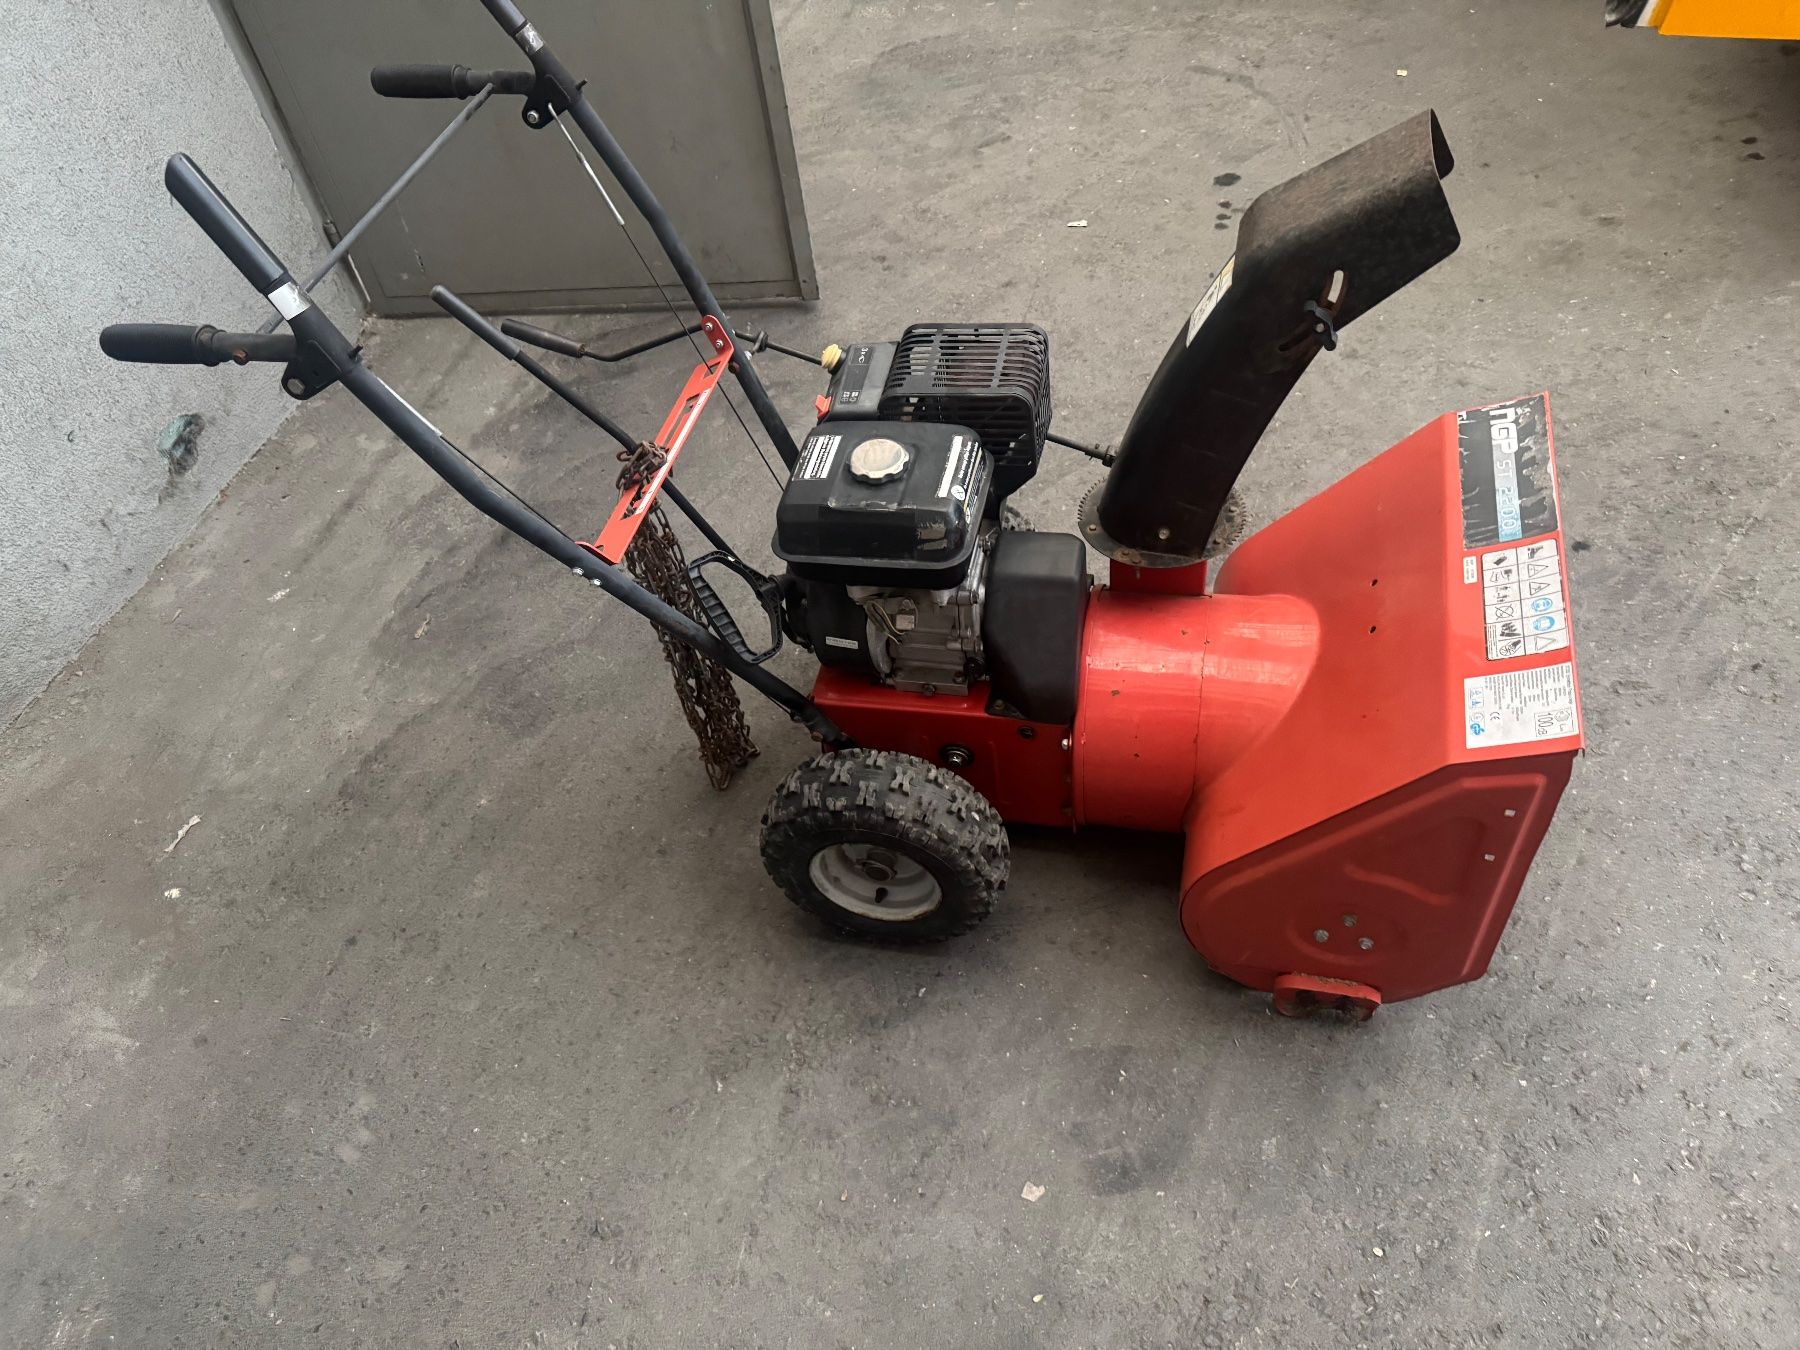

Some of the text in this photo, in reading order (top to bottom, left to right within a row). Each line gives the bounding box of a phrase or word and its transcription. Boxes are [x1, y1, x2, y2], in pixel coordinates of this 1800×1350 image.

[1496, 460, 1512, 478] ST
[1499, 487, 1517, 529] 2200
[1538, 712, 1554, 728] 100
